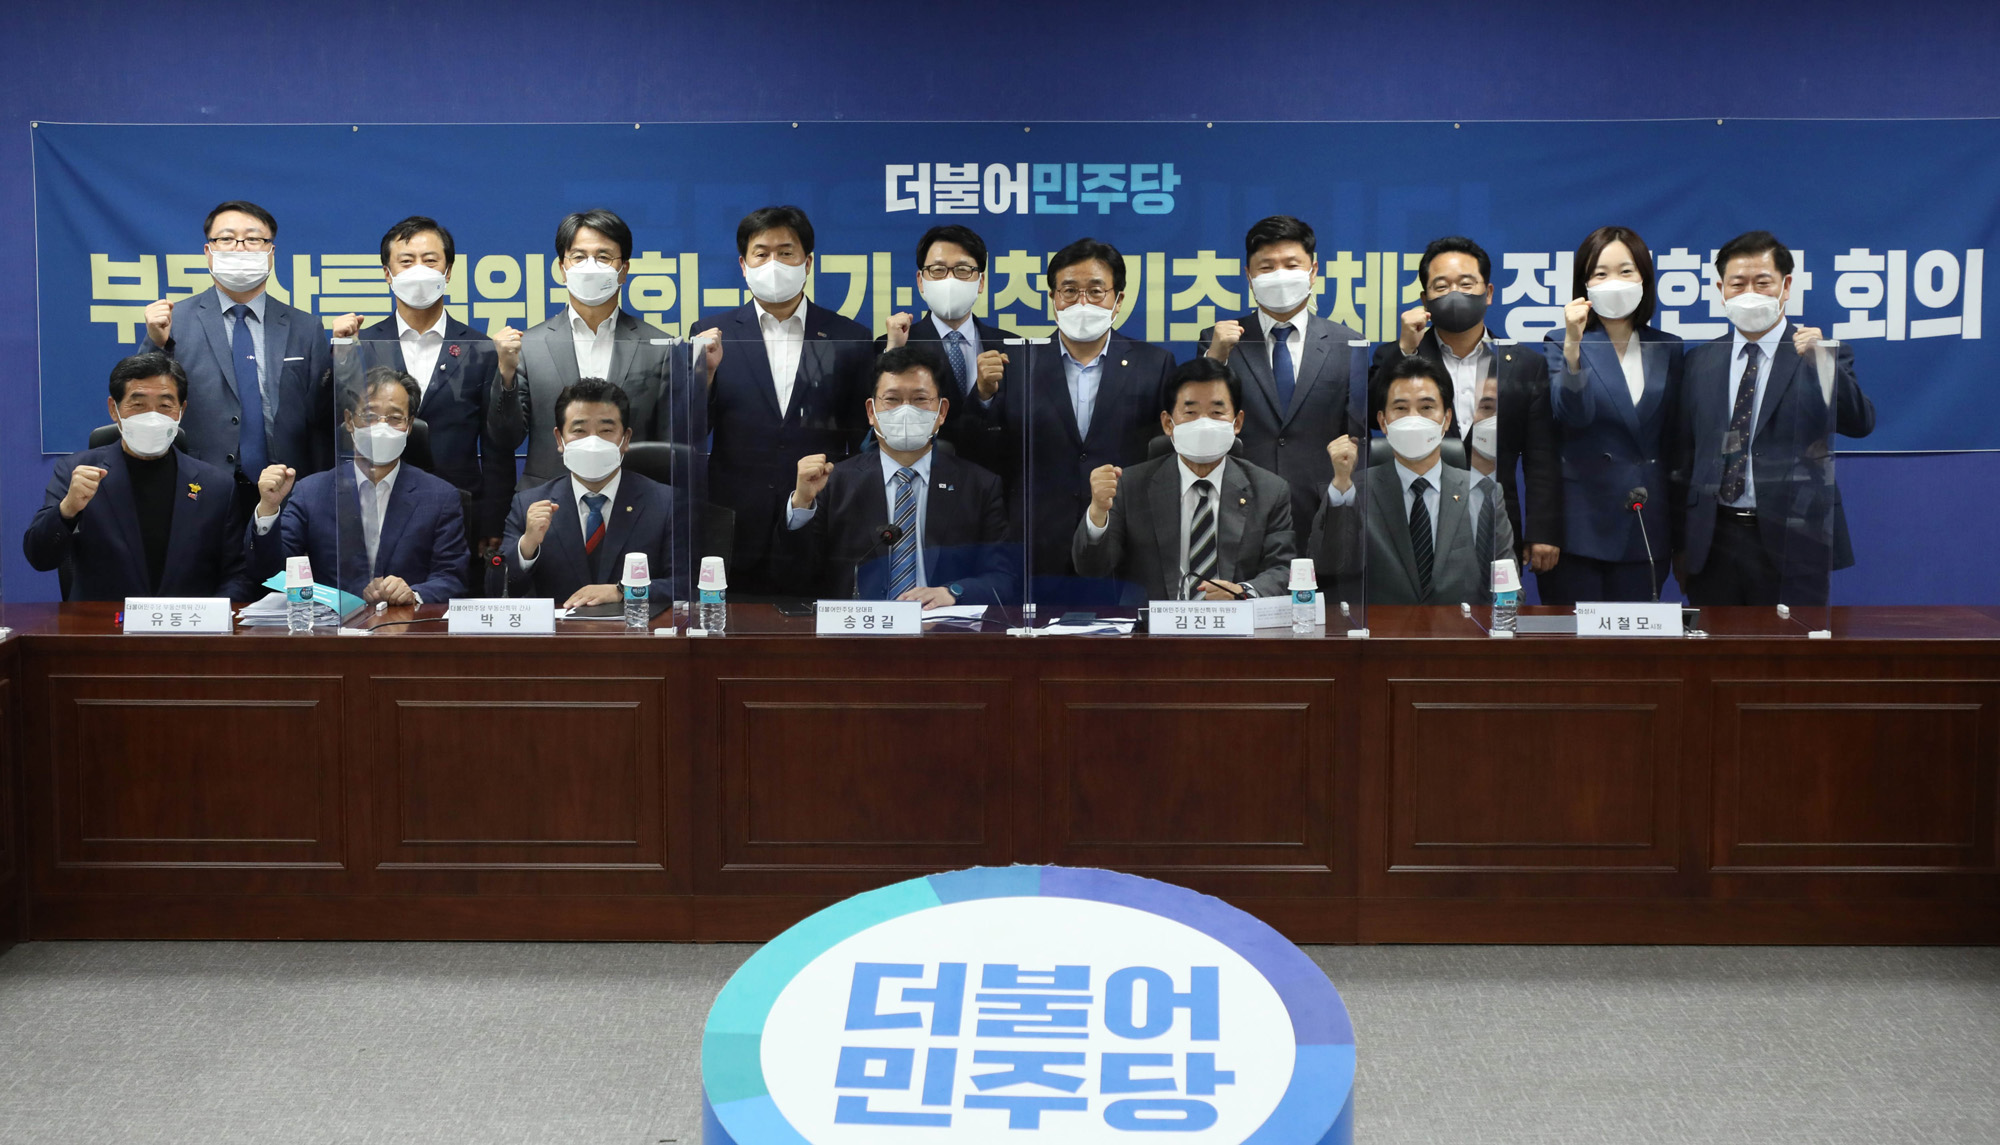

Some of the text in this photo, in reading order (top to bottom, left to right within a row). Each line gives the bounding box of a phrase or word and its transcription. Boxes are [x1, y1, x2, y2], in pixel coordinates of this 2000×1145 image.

[884, 161, 1182, 215] 더불어민주당
[1502, 247, 1814, 343] 정현
[1833, 247, 1985, 341] 회의
[126, 603, 162, 611] 더불어민주당
[163, 603, 194, 611] 부동산특위
[450, 604, 486, 612] 더불어민주당
[487, 604, 518, 612] 부동산특위
[844, 961, 1221, 1041] 더불어
[833, 1045, 1236, 1132] 민주당
